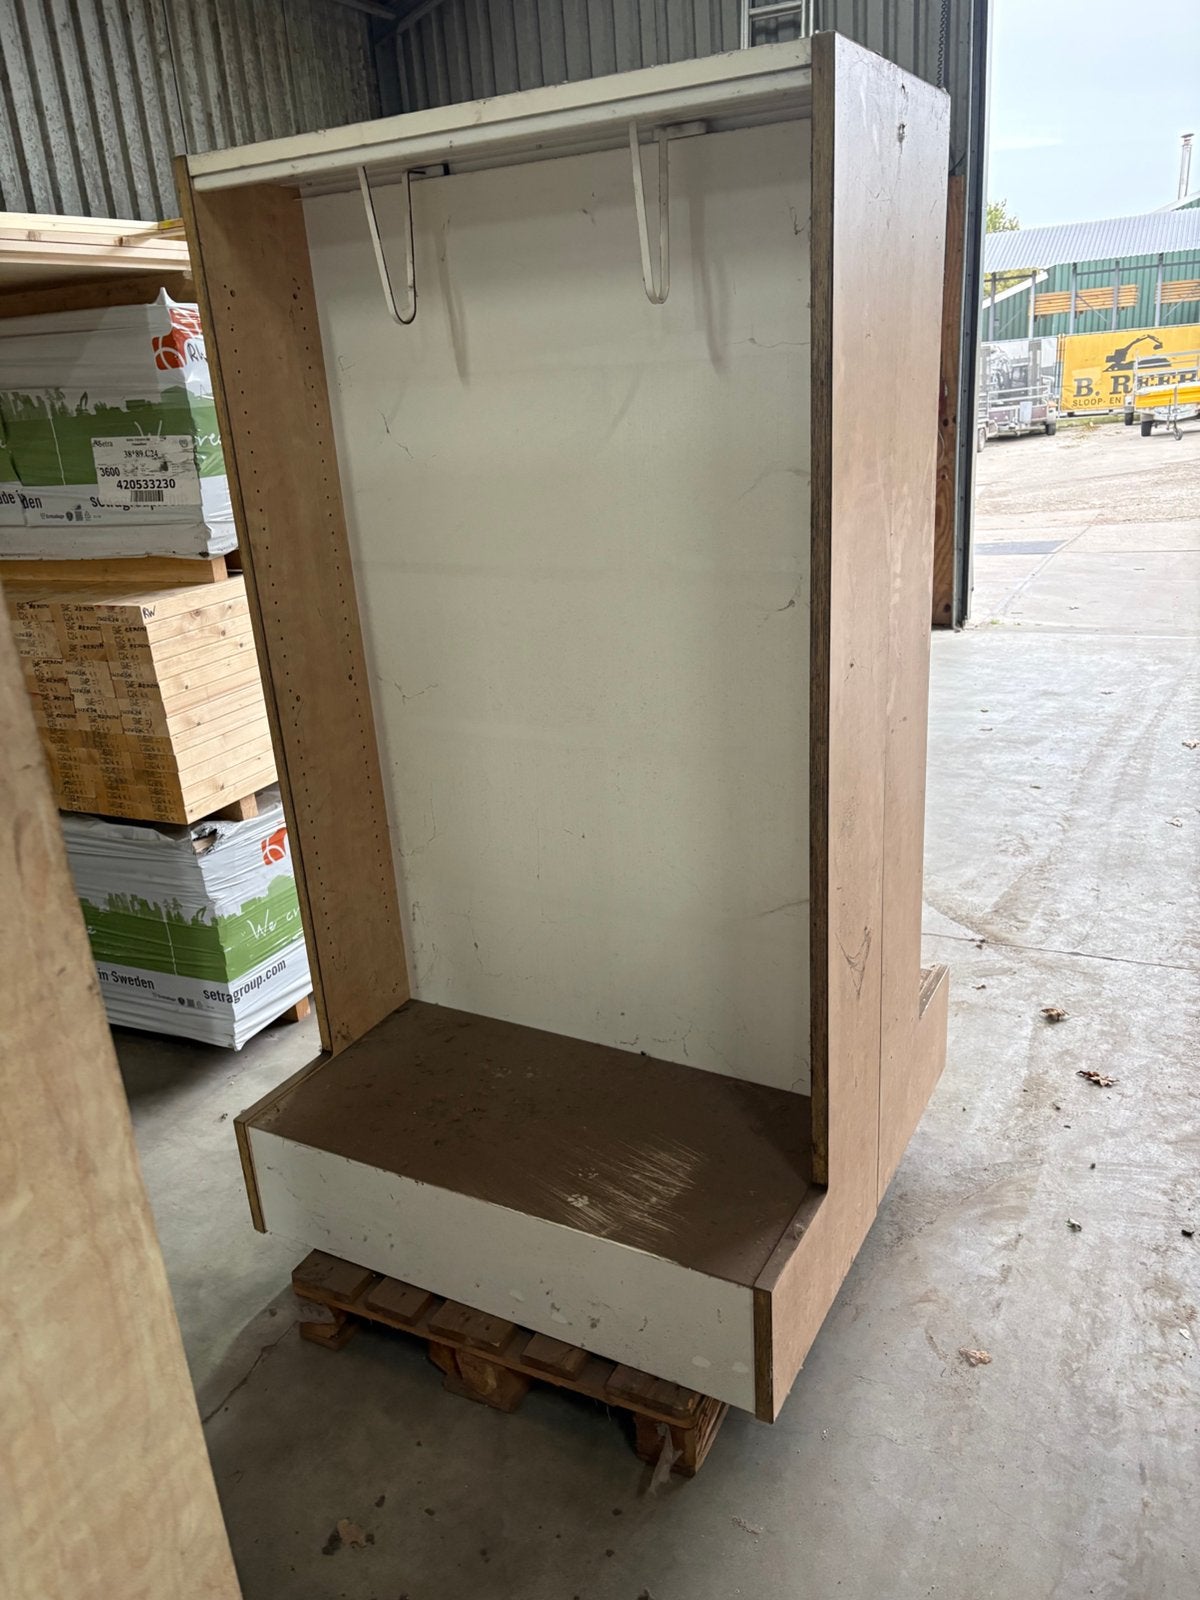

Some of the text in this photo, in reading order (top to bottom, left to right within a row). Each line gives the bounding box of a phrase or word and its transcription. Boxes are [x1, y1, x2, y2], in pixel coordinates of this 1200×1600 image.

[1073, 377, 1100, 398] B.
[1072, 396, 1121, 407] SLOOP- EN
[100, 467, 121, 477] 3600
[116, 479, 176, 490] 420533230
[112, 971, 155, 990] Sweden
[203, 960, 287, 1003] setragroup.com
